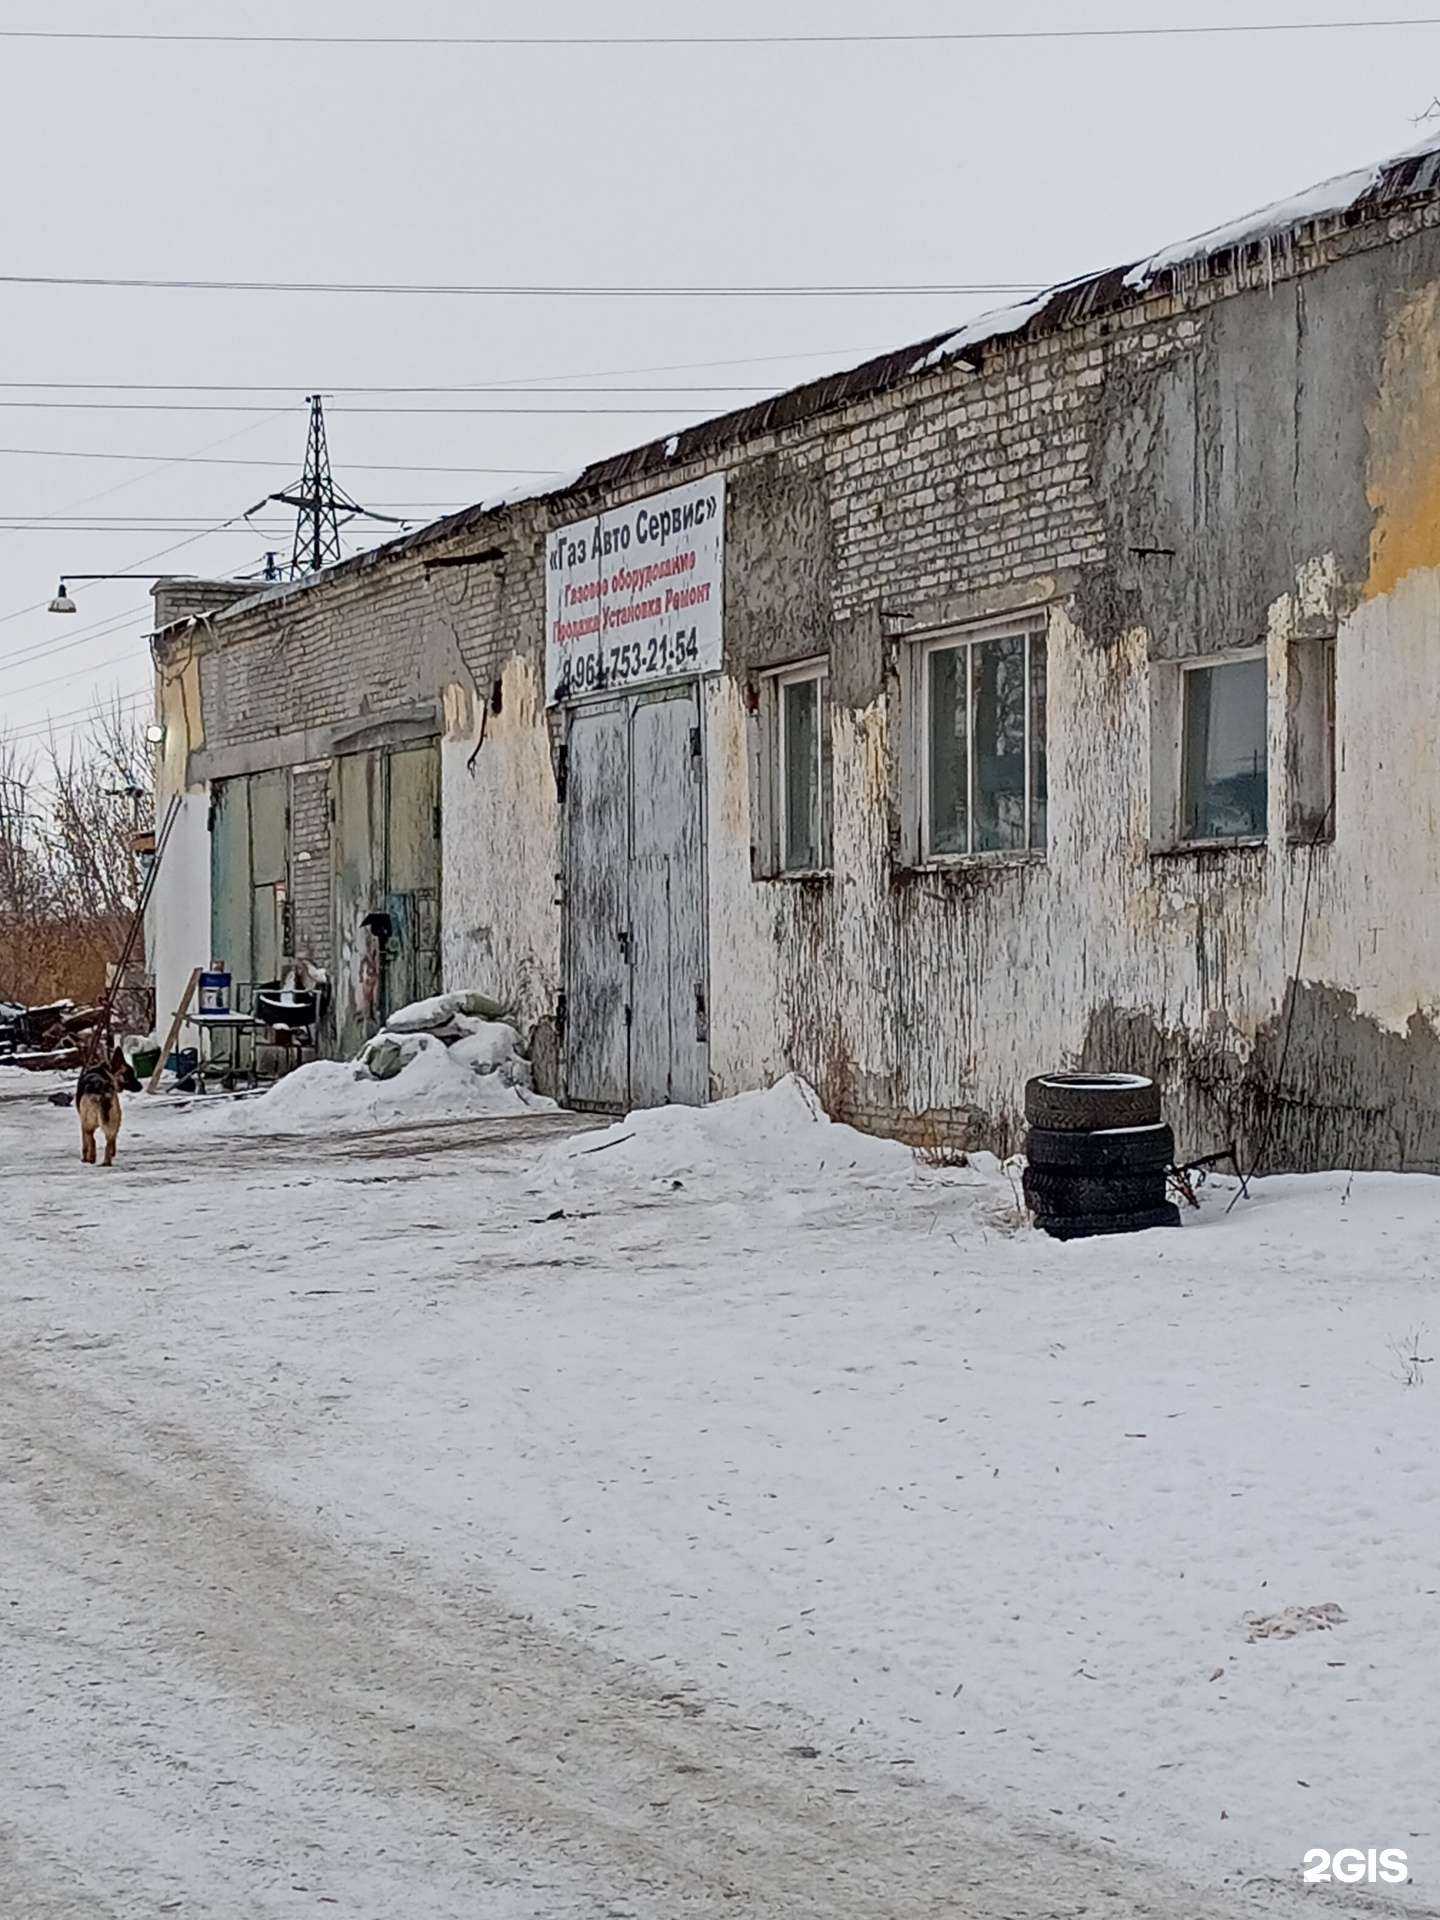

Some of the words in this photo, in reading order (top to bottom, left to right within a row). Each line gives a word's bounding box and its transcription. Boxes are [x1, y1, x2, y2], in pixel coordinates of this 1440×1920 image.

[549, 537, 586, 571] «Газ
[591, 523, 631, 560] Авто
[636, 496, 717, 547] Сервис»
[612, 551, 696, 594] оборудование
[602, 597, 661, 631] Установка
[665, 582, 711, 613] Ремонт
